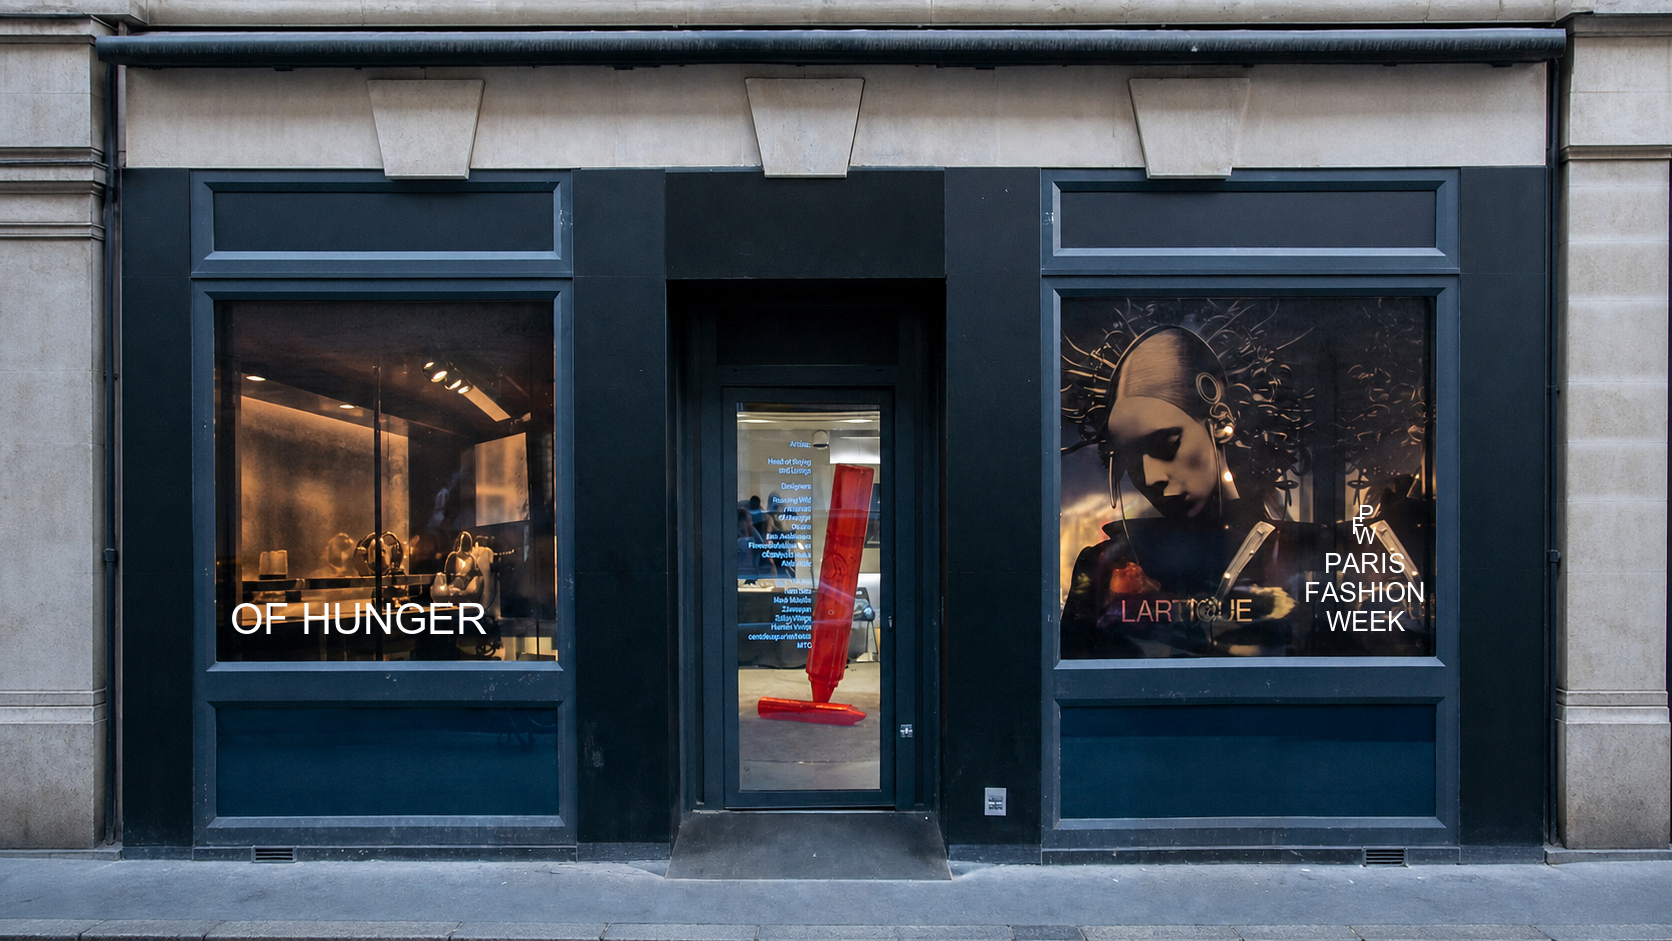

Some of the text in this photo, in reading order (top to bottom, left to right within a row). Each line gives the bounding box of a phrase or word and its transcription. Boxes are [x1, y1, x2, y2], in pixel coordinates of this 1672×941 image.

[1326, 552, 1405, 574] PARIS
[1306, 581, 1424, 603] FASHION
[232, 602, 486, 635] OF HUNGER
[1326, 610, 1405, 632] WEEK
